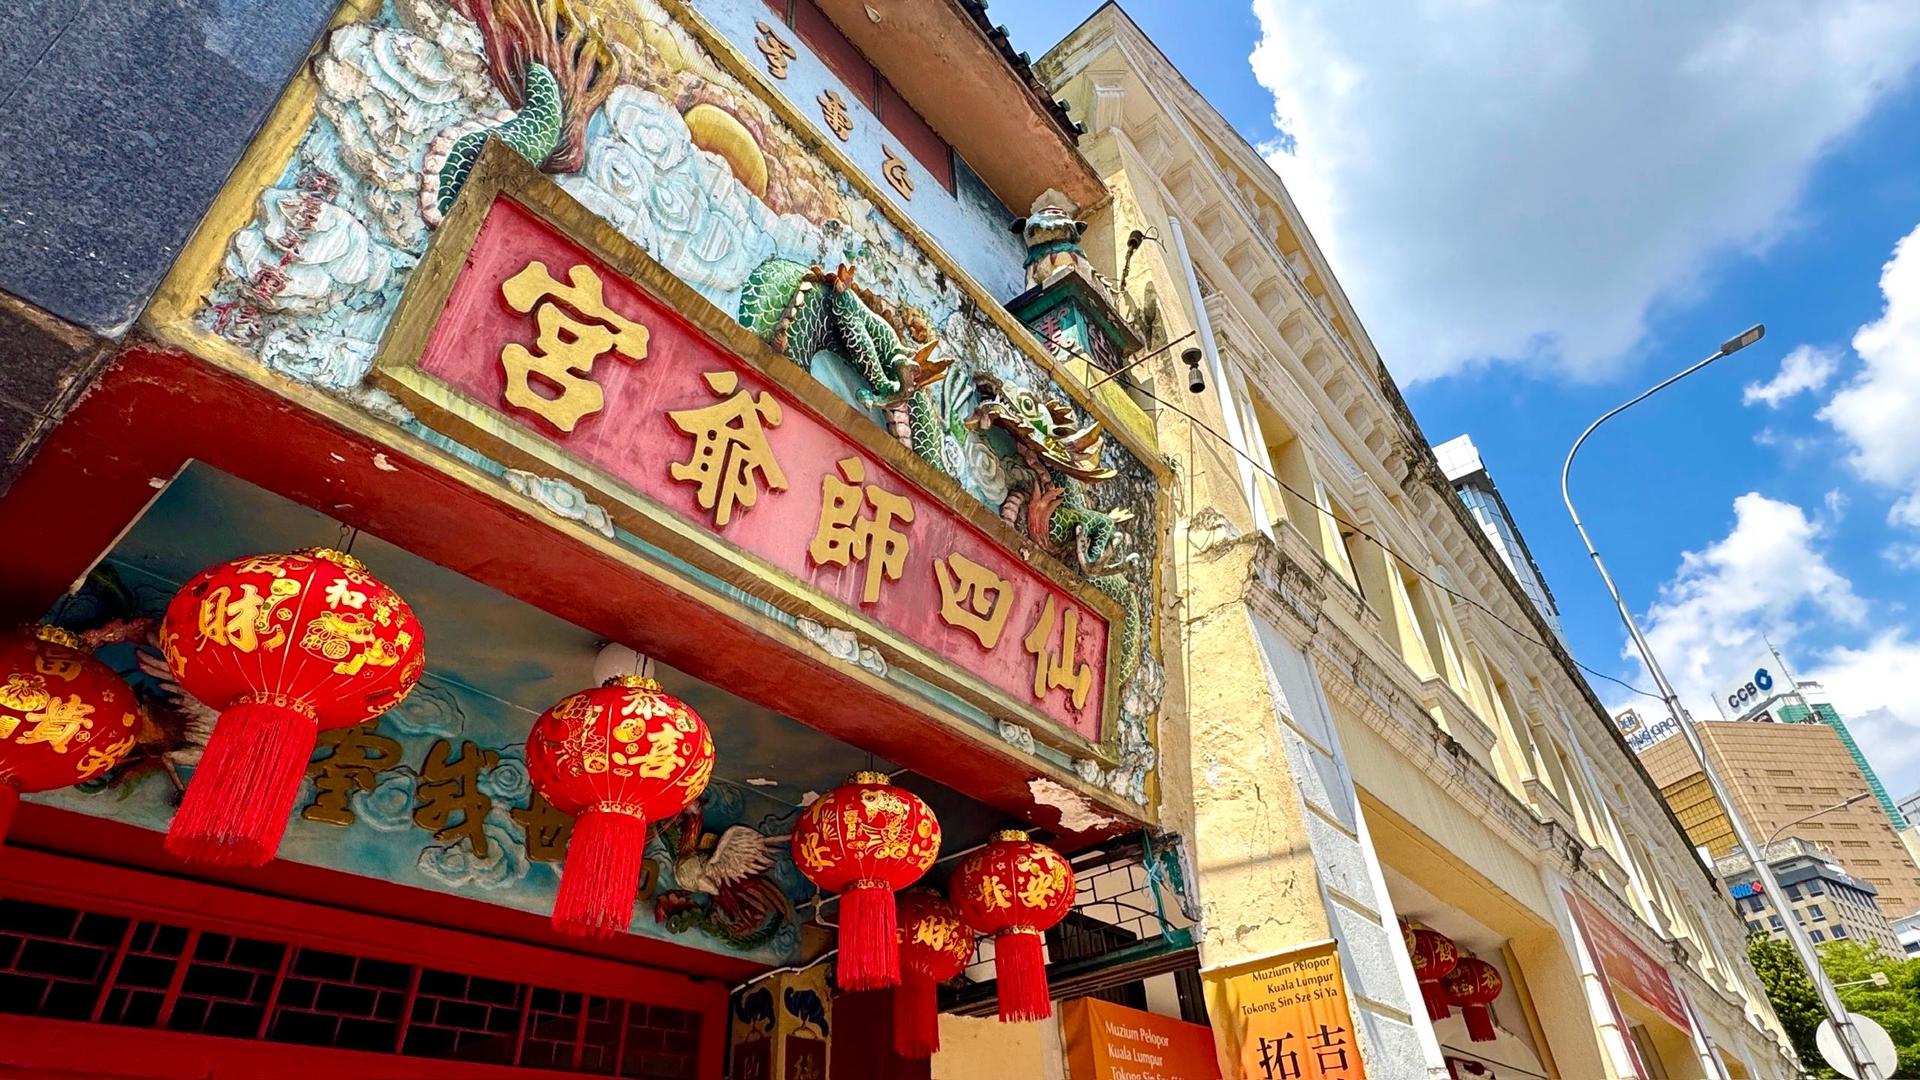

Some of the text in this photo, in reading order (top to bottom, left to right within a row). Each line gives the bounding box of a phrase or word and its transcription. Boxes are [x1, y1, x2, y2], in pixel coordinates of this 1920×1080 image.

[1728, 682, 1758, 709] CCB
[1252, 958, 1330, 982] Muzium Pelopor
[1267, 973, 1334, 994] Kuala Lumpur
[1241, 987, 1338, 1016] Tokong Sin Sze Si Ya
[1104, 1020, 1169, 1049] Muzium Pelopor
[1108, 1043, 1163, 1069] Kuala Lumpur
